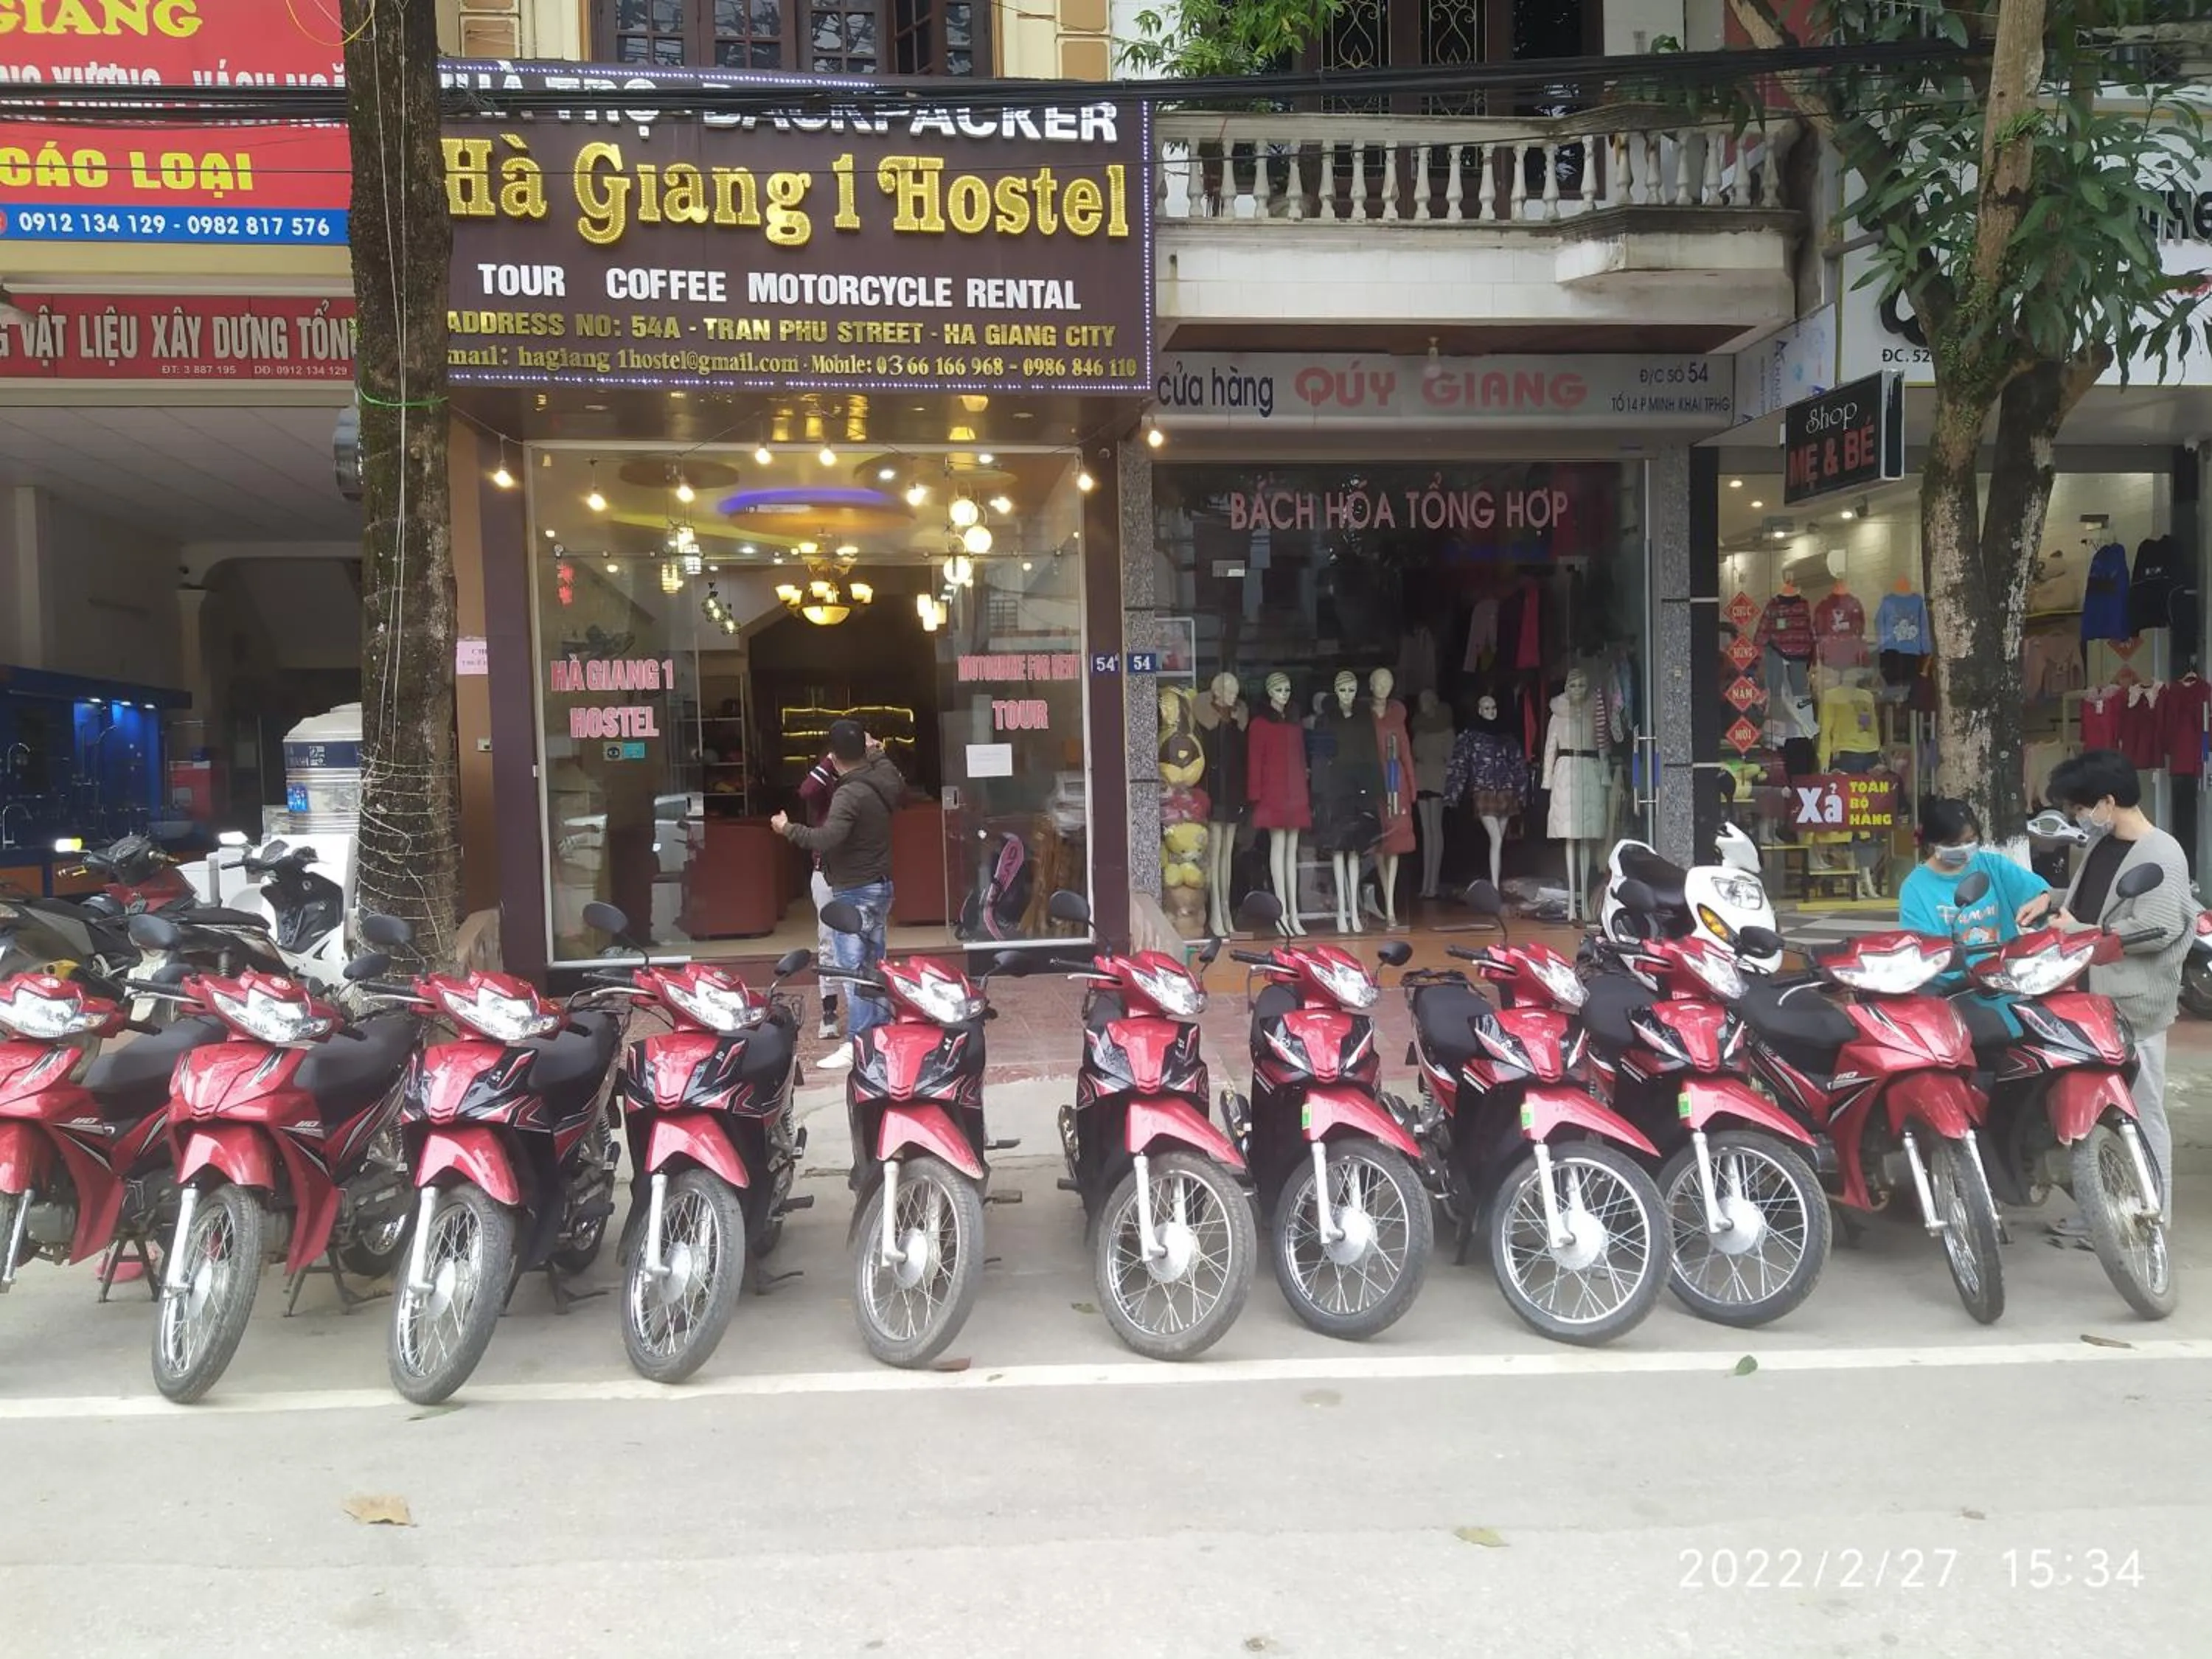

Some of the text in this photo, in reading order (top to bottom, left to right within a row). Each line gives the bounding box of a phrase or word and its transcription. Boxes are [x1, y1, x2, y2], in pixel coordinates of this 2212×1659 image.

[0, 141, 254, 198] CÁC LOẠI
[441, 133, 1130, 246] Hà Giang 1 Hostel
[18, 212, 74, 234] 0912
[80, 213, 120, 233] 134
[128, 215, 166, 234] 129
[187, 215, 240, 235] 0982
[246, 217, 282, 235] 817
[291, 218, 330, 237] 576
[477, 262, 1082, 310] TOUR COFFEE MOTORCYCLE RENTAL
[20, 305, 67, 366] VẬT
[78, 305, 138, 366] LIỆU
[151, 306, 201, 359] XÂY
[296, 299, 357, 361] TỔN
[447, 310, 566, 336] ADDRESS
[575, 313, 622, 338] NO:
[631, 315, 681, 340] 54A
[703, 317, 771, 341] TRAN
[779, 319, 828, 344] PHU
[837, 321, 924, 344] STREET
[943, 324, 977, 346] HA
[984, 324, 1057, 348] GIANG
[1065, 324, 1116, 348] CITY
[518, 347, 611, 373] hagiang
[811, 354, 872, 375] Mobile:
[934, 356, 967, 377] 166
[971, 357, 1004, 377] 968
[1022, 358, 1066, 378] 0986
[1071, 358, 1104, 378] 846
[1109, 358, 1137, 378] 110
[1687, 362, 1708, 383] 54
[1157, 361, 1204, 407] cửa
[1211, 365, 1274, 418] hàng
[1421, 371, 1588, 408] GIANG
[1806, 401, 1858, 434] Shop
[1844, 414, 1875, 470] BÉ
[1230, 472, 1568, 537] BÁCH HÓA TỔNG HỢP
[551, 653, 675, 692] HÀ GIANG 1
[1133, 655, 1151, 671] 54
[569, 705, 661, 738] HOSTEL
[991, 700, 1049, 731] TOUR
[1795, 782, 1843, 824] Xả
